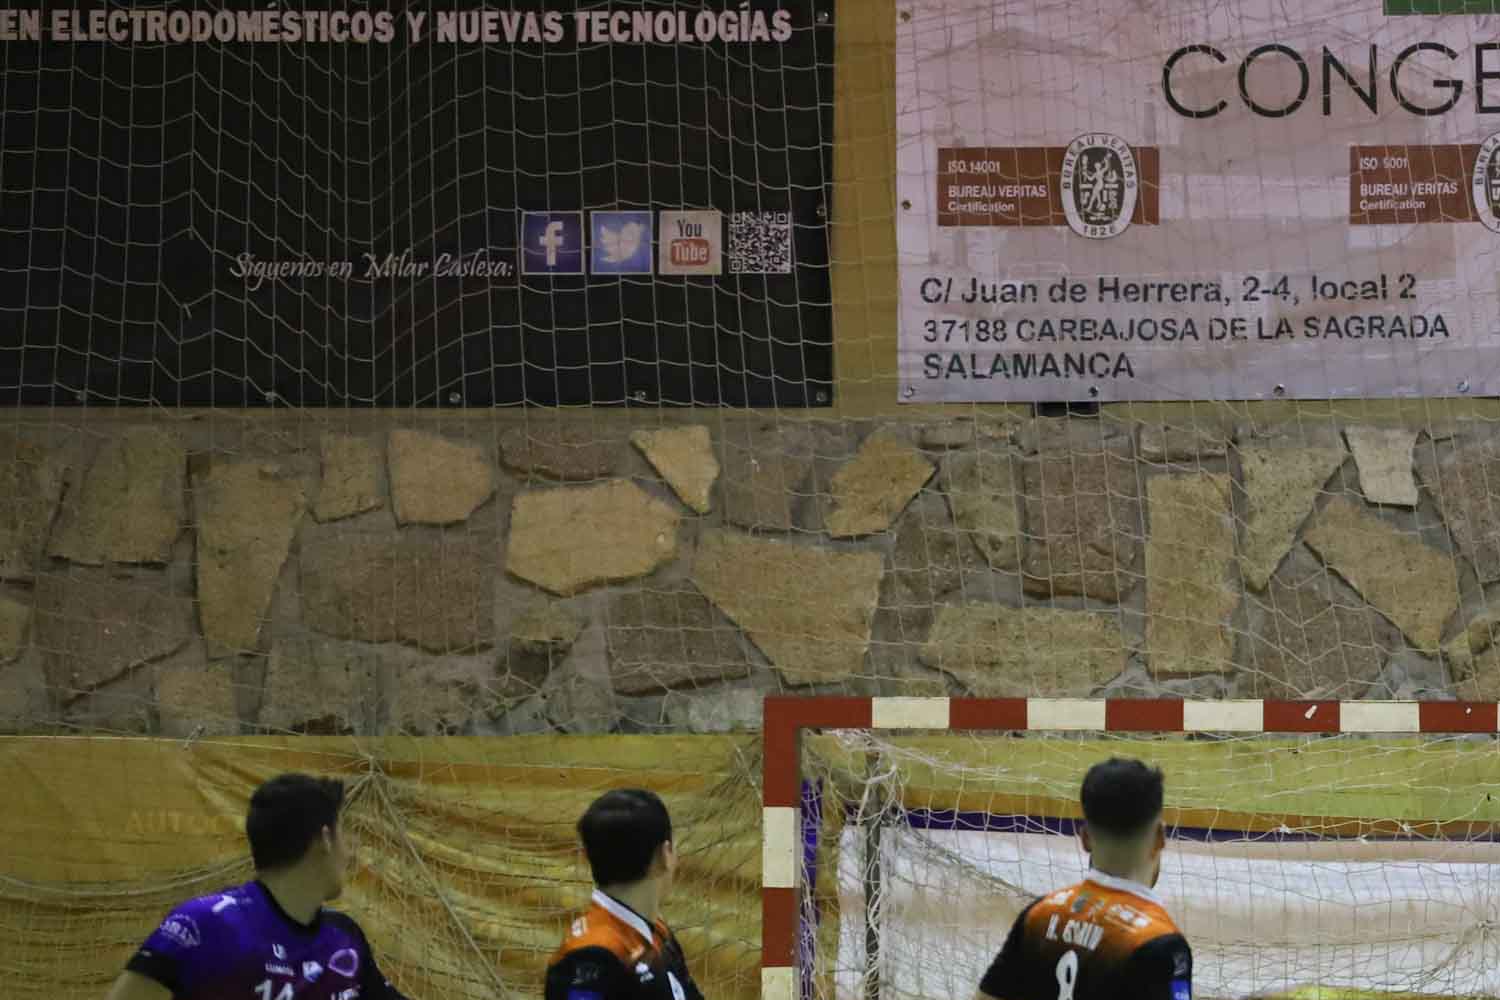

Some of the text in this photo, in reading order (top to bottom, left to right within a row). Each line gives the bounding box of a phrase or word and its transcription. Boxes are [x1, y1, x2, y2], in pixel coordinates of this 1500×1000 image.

[1, 2, 792, 43] EN ELECTRODOMÉSTICOS Y NUEVAS TECNOLOGÍAS
[948, 160, 966, 173] ISO
[1360, 157, 1376, 170] ISO
[948, 184, 1047, 198] BUREAU VERITAS
[1360, 182, 1458, 197] BUREAU VERITAS
[948, 201, 1014, 212] Certification
[1360, 199, 1426, 210] Certification
[676, 219, 702, 238] You
[672, 242, 709, 263] Tube
[362, 247, 429, 278] Milar
[920, 273, 1418, 306] C/ Juan de Herrera, 2-4, local 2
[923, 314, 1451, 343] 37188 CARBAJOSA DE LA SAGRADA
[923, 352, 1136, 380] SALAMANCA
